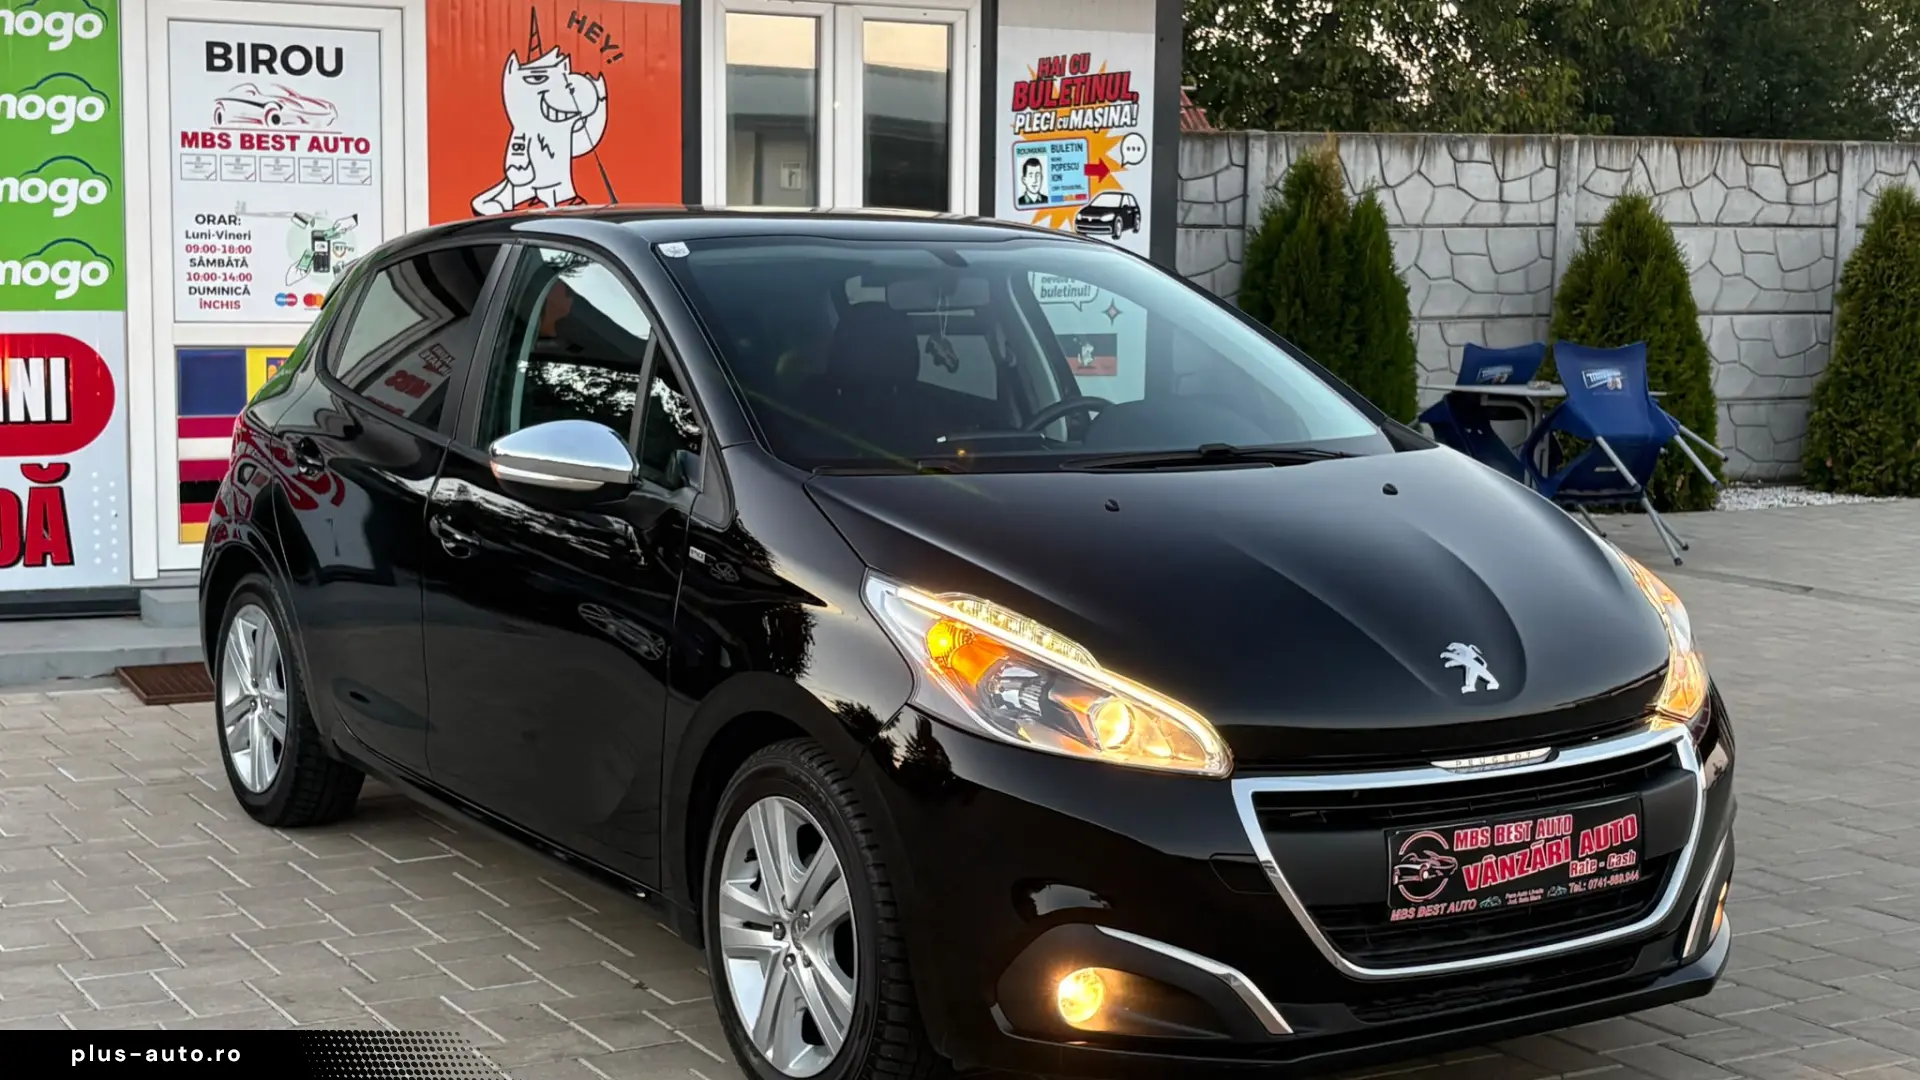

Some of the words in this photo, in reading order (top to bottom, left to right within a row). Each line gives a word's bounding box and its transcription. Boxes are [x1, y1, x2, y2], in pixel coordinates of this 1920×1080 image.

[567, 10, 624, 64] HEY!
[205, 40, 344, 78] BIROU
[1037, 54, 1066, 77] HAI
[1069, 52, 1091, 75] CU
[1012, 71, 1139, 112] BULETINUL,
[1014, 111, 1056, 135] PLECI
[180, 130, 232, 151] MBS
[240, 133, 300, 153] BEST
[307, 135, 371, 155] AUTO
[511, 132, 526, 157] TBI
[1050, 142, 1084, 154] BULETIN
[1051, 162, 1080, 172] POPESCU
[194, 213, 242, 226] ORAR:
[185, 229, 252, 241] Luni-Vineri
[185, 243, 252, 254] 09:00-18:00
[186, 271, 253, 282] 10:00-14:00
[188, 284, 251, 296] DUMINICĂ
[199, 297, 241, 310] ÎNCHIS
[0, 356, 68, 422] NI
[1455, 751, 1532, 767] PEUGEOT
[1454, 827, 1491, 851] MBS
[1494, 820, 1533, 846] BEST
[1535, 814, 1573, 841] AUTO
[1461, 837, 1572, 891] VÂNZĂRI
[1578, 813, 1639, 859] AUTO
[1569, 858, 1597, 878] Rate
[1606, 850, 1637, 870] Cash
[1390, 907, 1416, 922] MBS
[1417, 902, 1448, 918] BEST
[1447, 899, 1477, 915] AUTO
